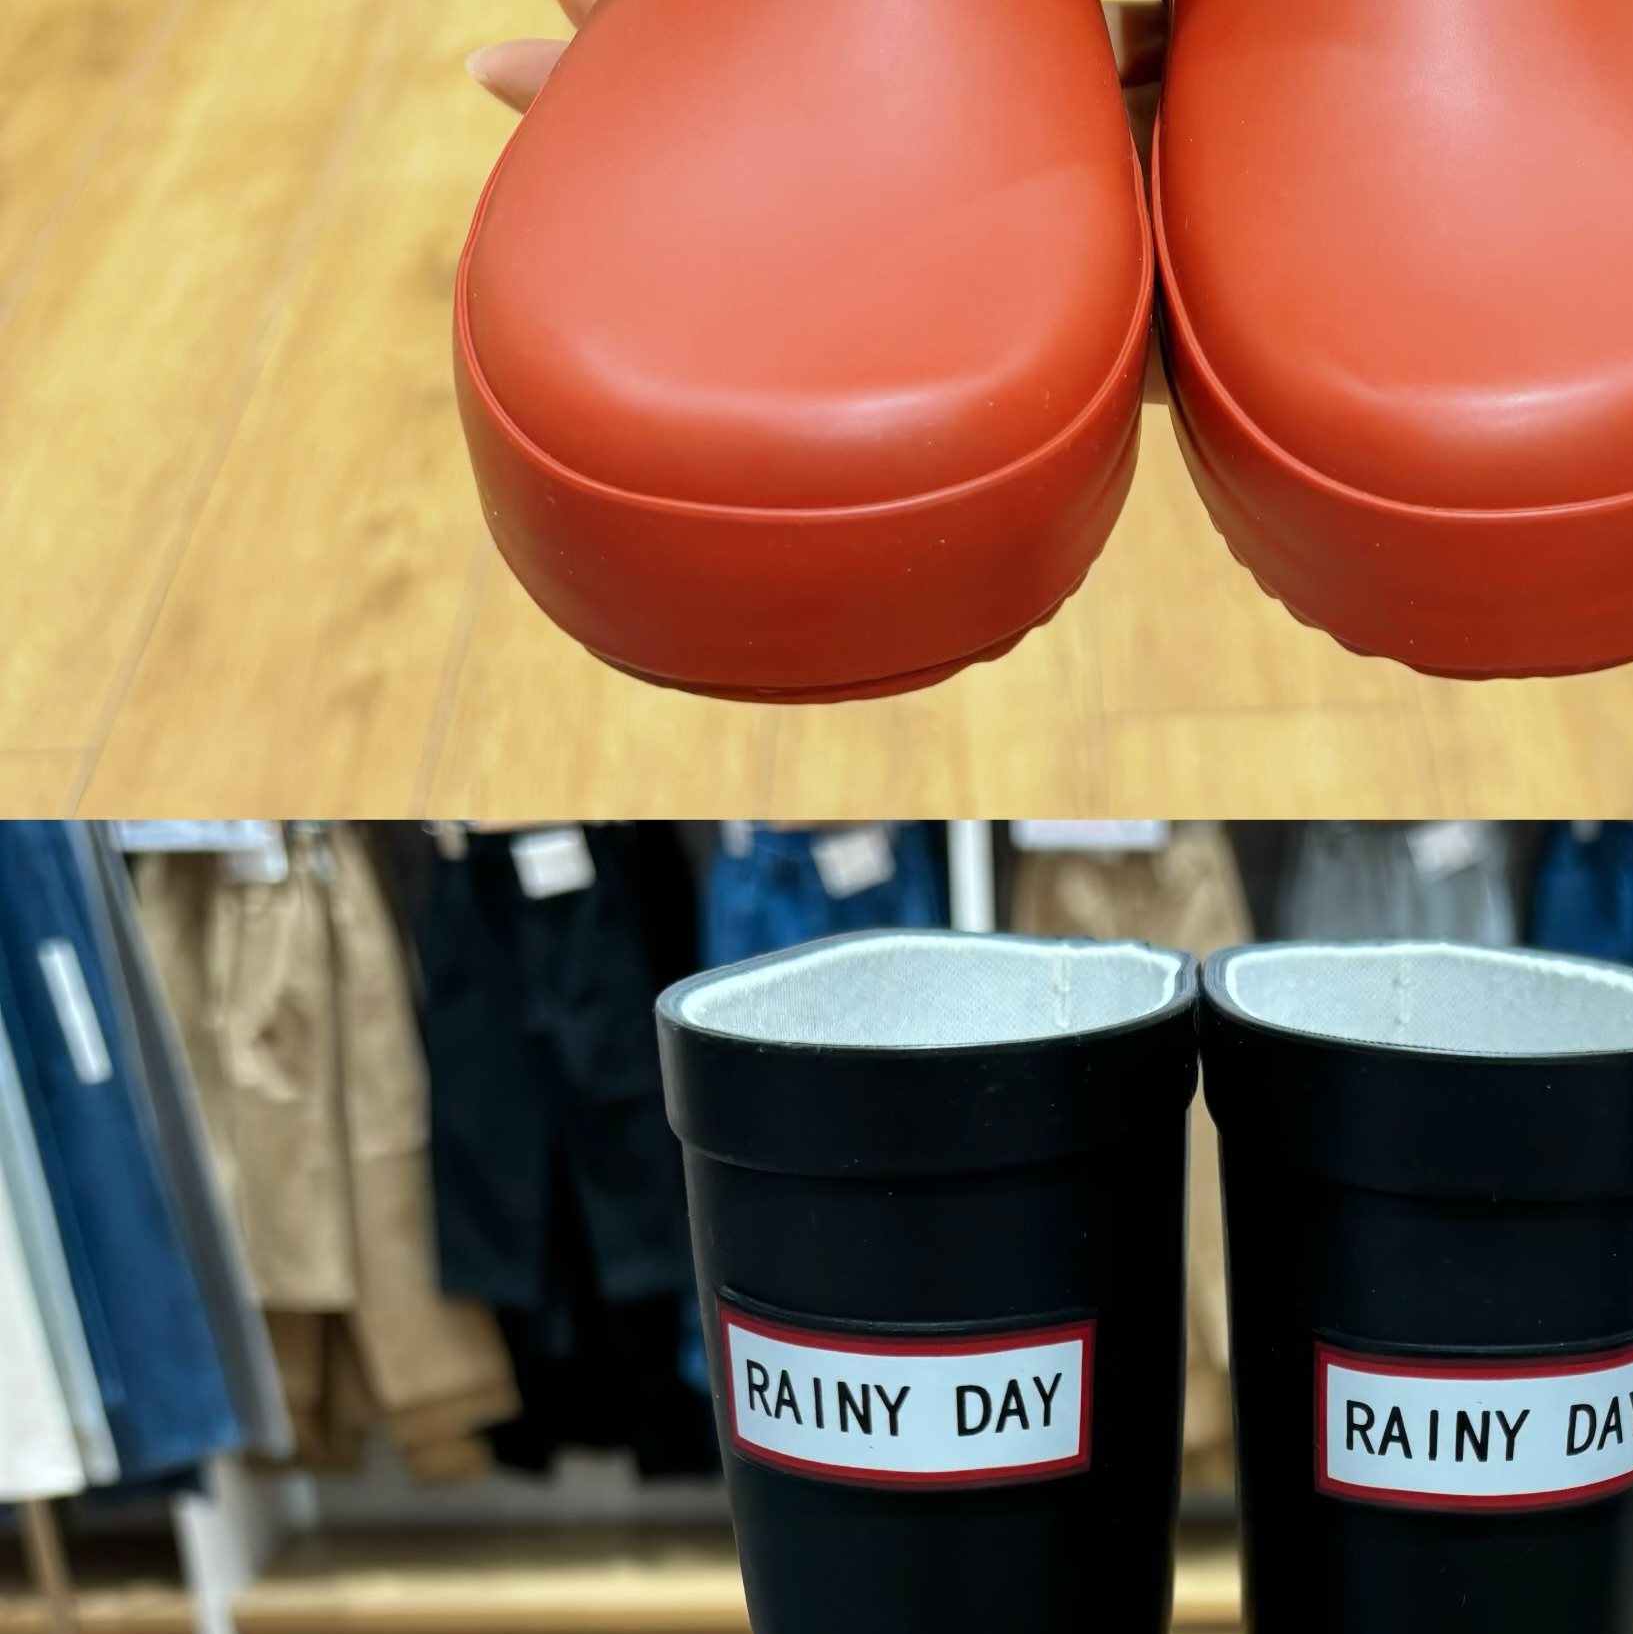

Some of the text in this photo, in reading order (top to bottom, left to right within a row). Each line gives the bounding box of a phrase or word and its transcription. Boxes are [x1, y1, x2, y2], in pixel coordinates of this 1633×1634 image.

[745, 1357, 1064, 1438] RAINY DAY
[1345, 1398, 1532, 1464] RAINY
